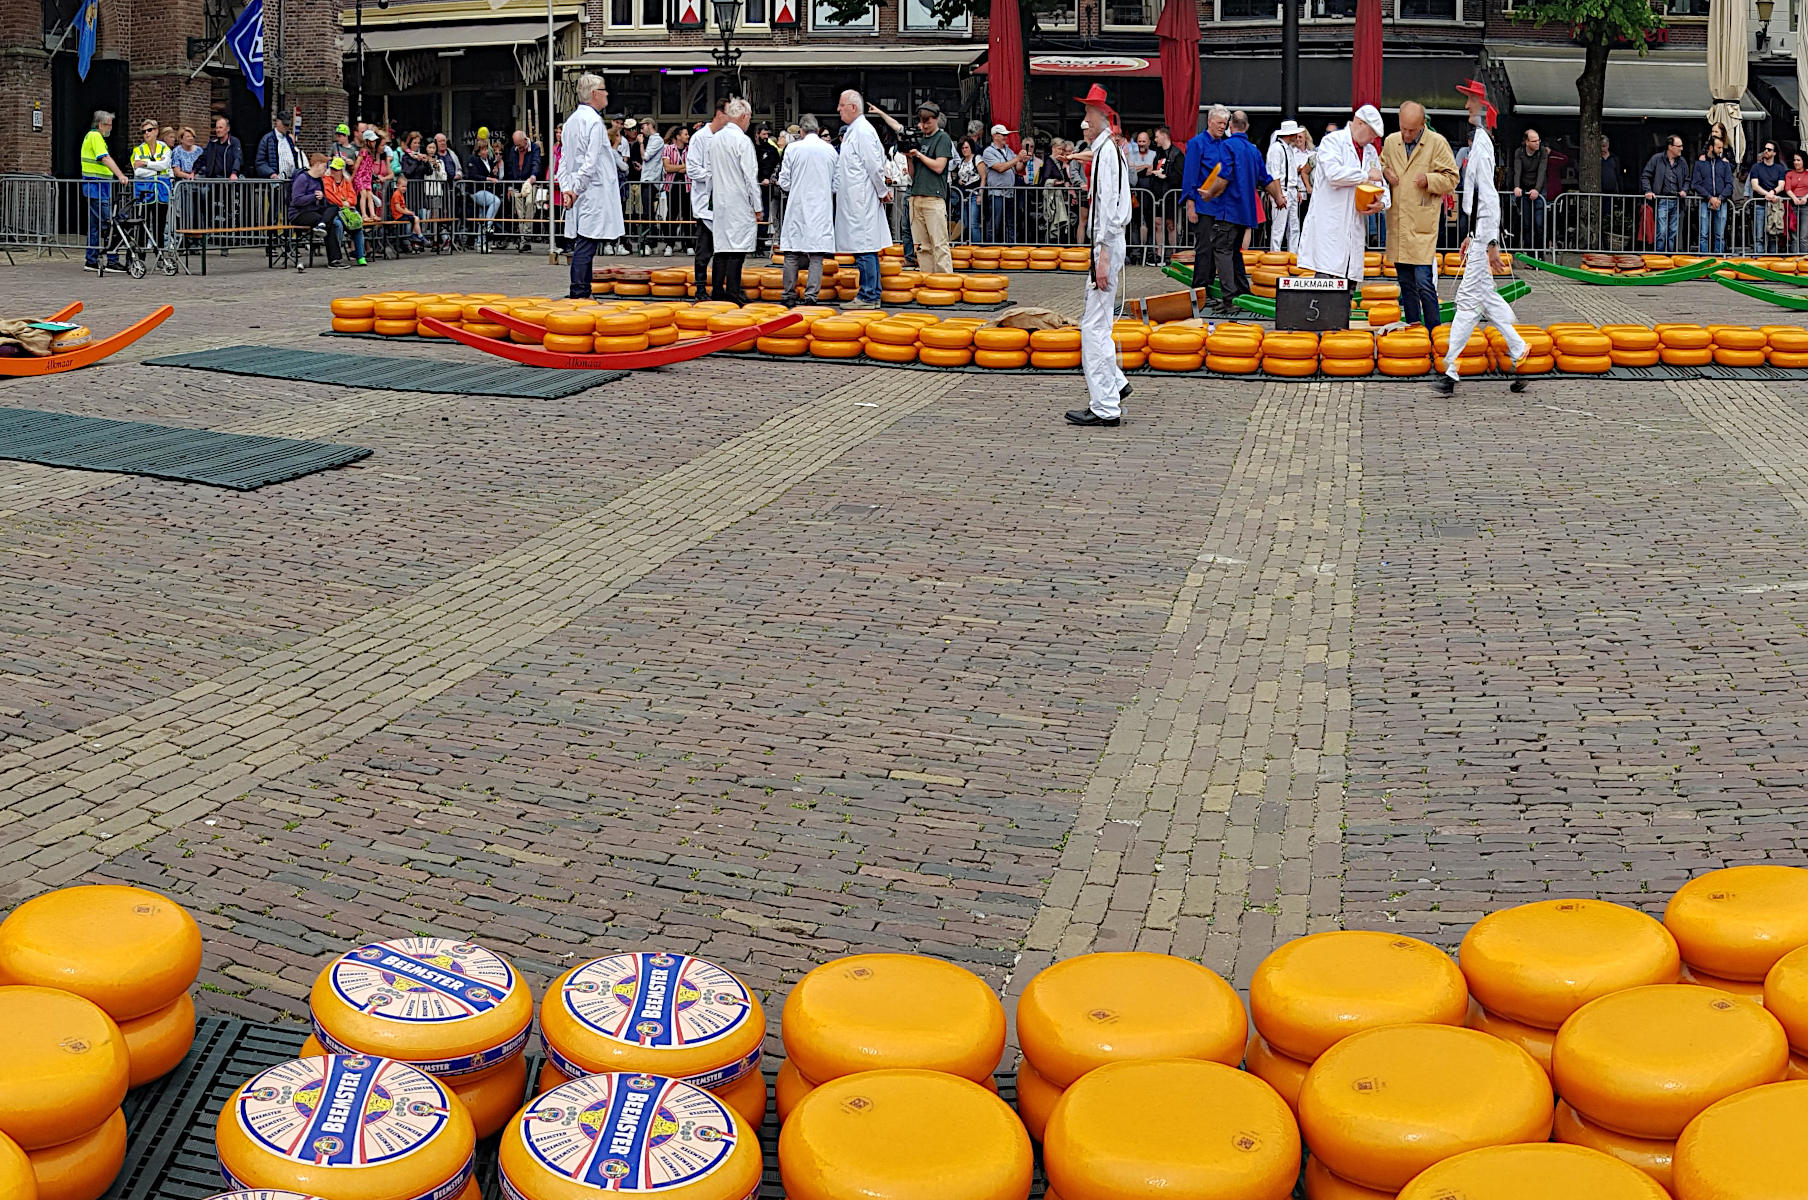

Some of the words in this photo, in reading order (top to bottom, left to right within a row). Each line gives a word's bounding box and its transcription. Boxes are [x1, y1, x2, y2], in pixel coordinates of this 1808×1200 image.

[1293, 280, 1334, 288] ALKMAAR
[1306, 299, 1320, 321] 5
[382, 956, 465, 990] BEEMSTER
[641, 969, 668, 1019] BEEMSTER
[321, 1071, 363, 1134] BEEMSTER
[609, 1092, 650, 1155] BEEMSTER
